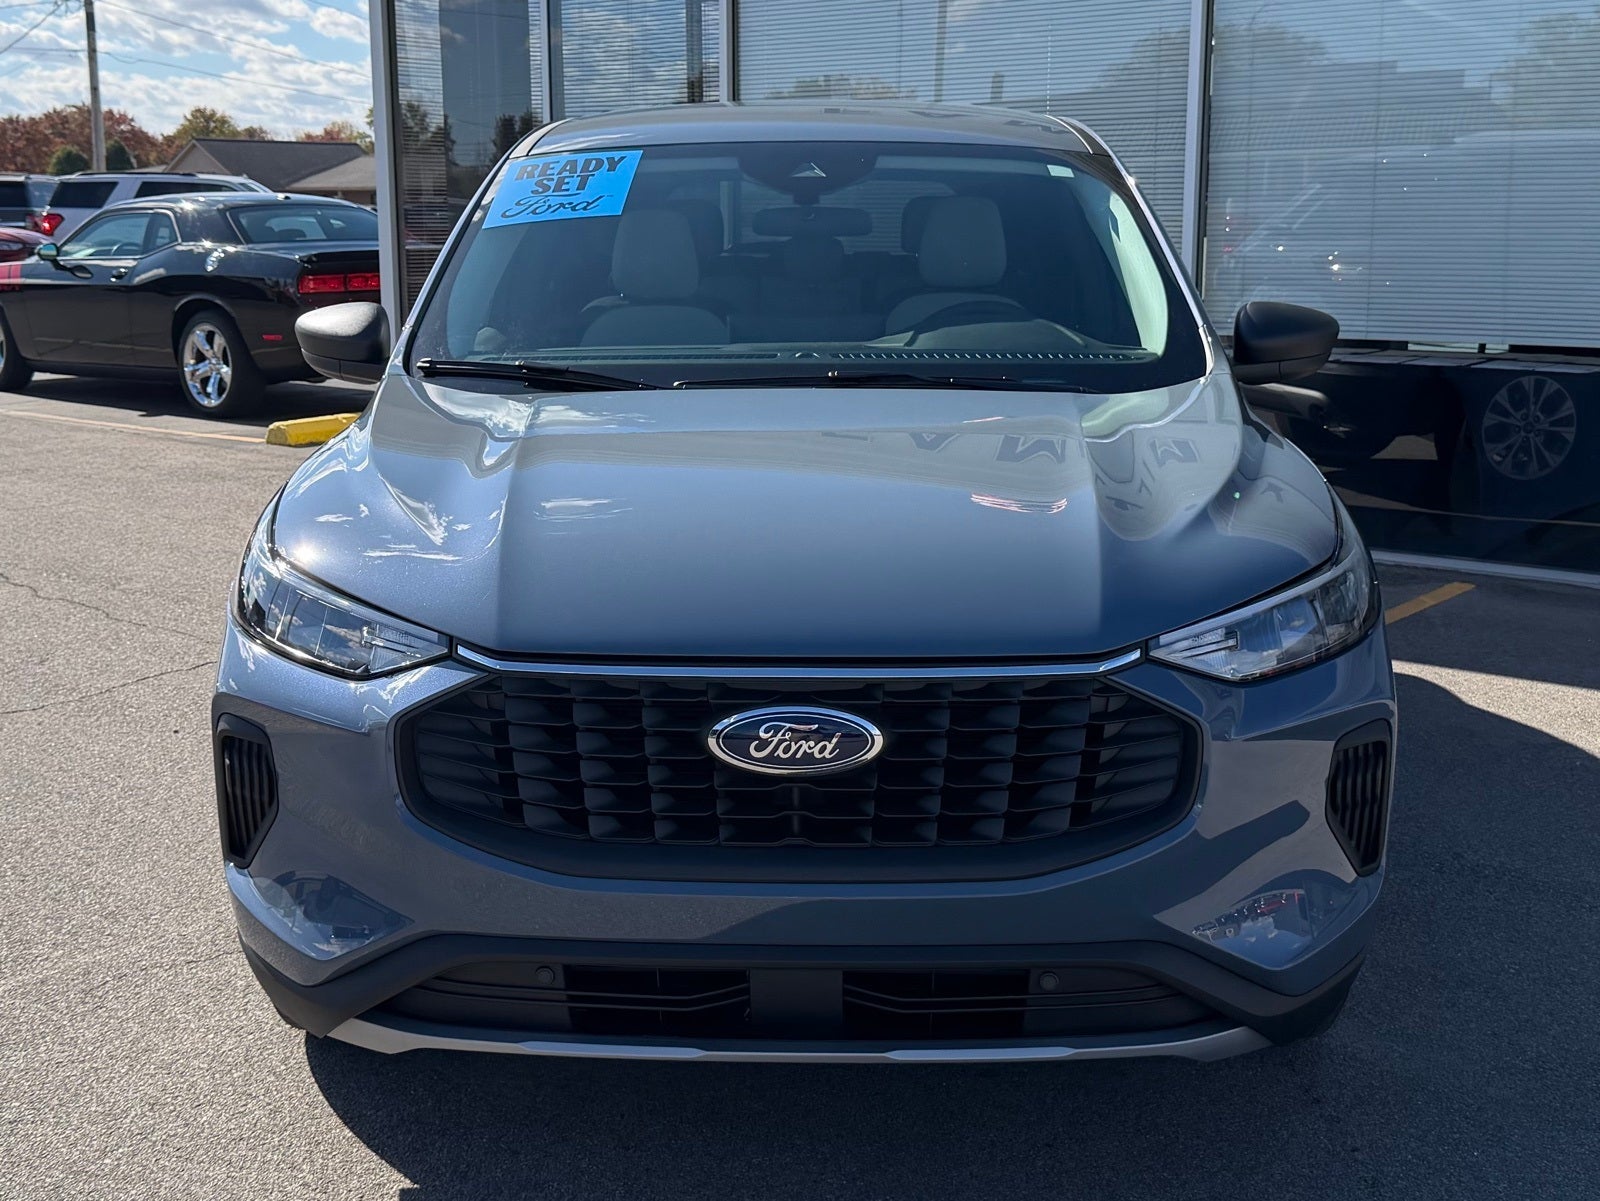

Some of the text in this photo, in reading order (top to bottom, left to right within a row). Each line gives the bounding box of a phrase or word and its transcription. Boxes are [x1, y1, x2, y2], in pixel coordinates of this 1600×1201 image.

[515, 156, 627, 181] READY
[530, 173, 595, 195] SET
[501, 192, 605, 219] Ford
[750, 721, 841, 759] Ford
